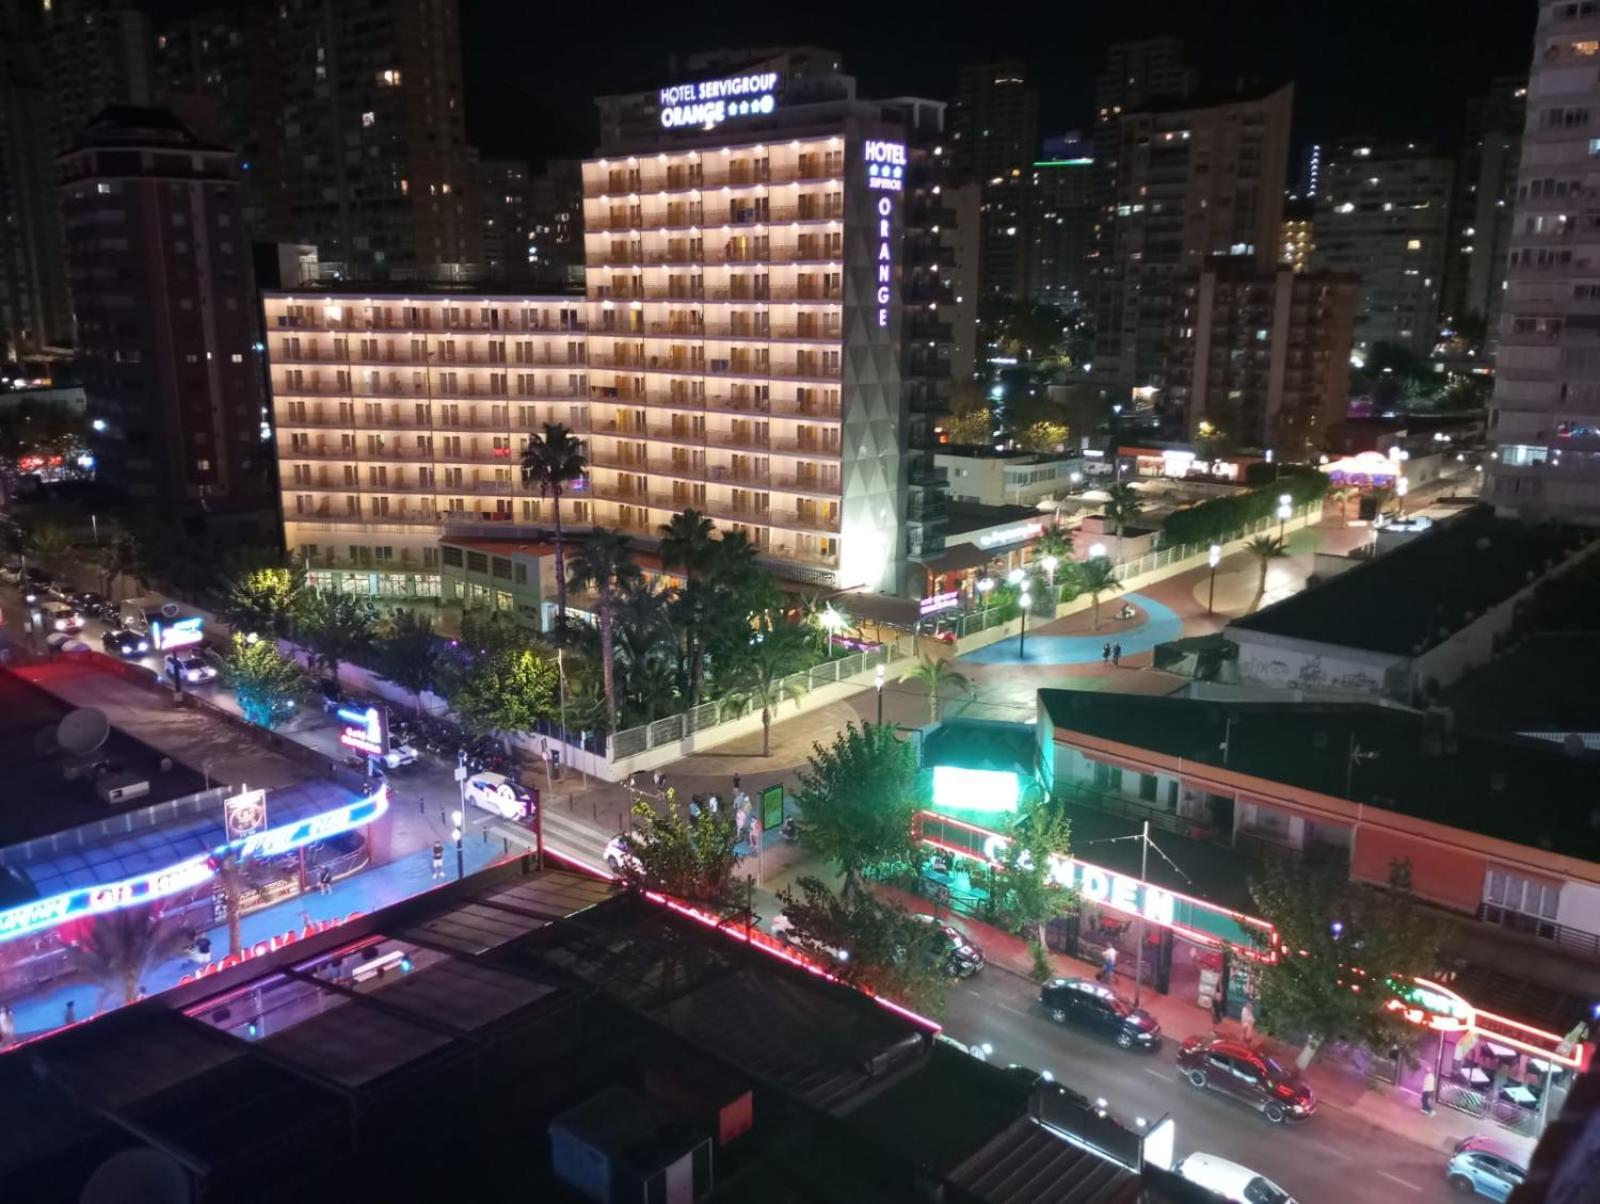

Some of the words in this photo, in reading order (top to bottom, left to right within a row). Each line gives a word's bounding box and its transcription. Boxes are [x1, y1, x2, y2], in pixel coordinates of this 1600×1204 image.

[661, 84, 696, 106] HOTEL
[699, 73, 777, 99] SERVIGROUP
[661, 101, 725, 128] ORANGE
[865, 140, 907, 165] HOTEL
[878, 197, 891, 326] ORANGE
